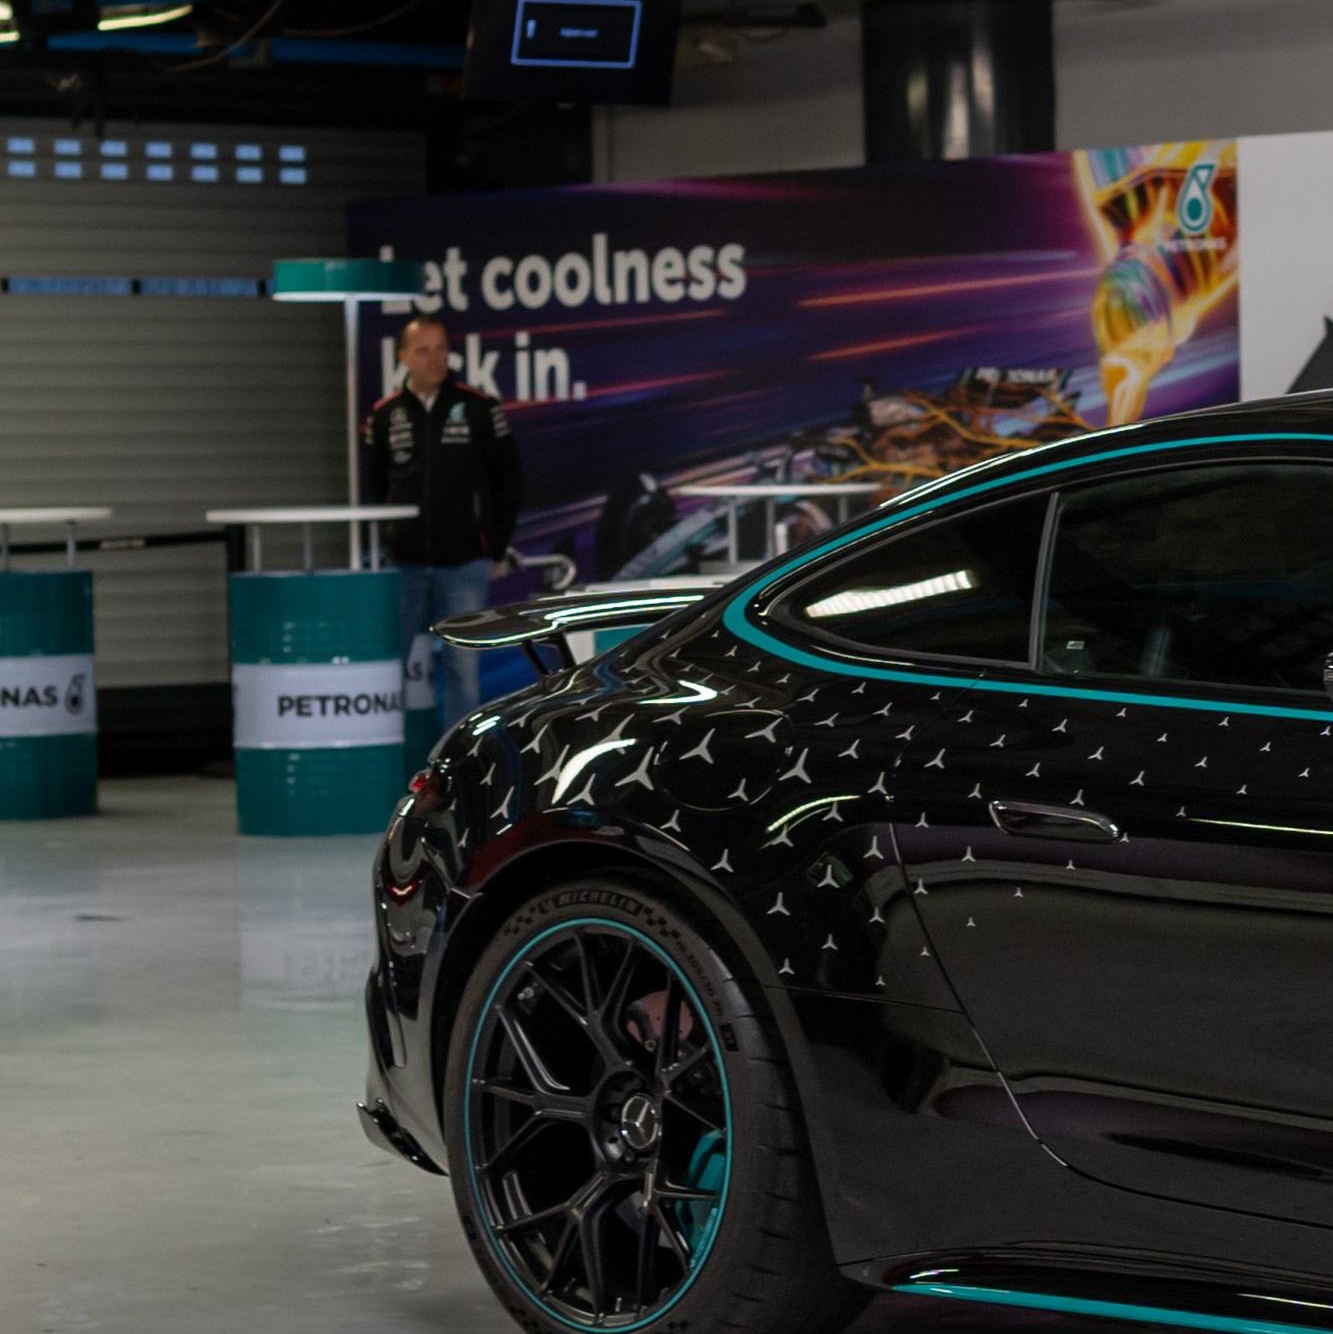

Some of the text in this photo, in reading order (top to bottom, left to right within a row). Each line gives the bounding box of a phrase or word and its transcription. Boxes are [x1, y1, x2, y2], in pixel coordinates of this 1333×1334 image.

[481, 232, 747, 310] coolness
[515, 330, 587, 401] in.
[558, 890, 640, 915] MICHELIN
